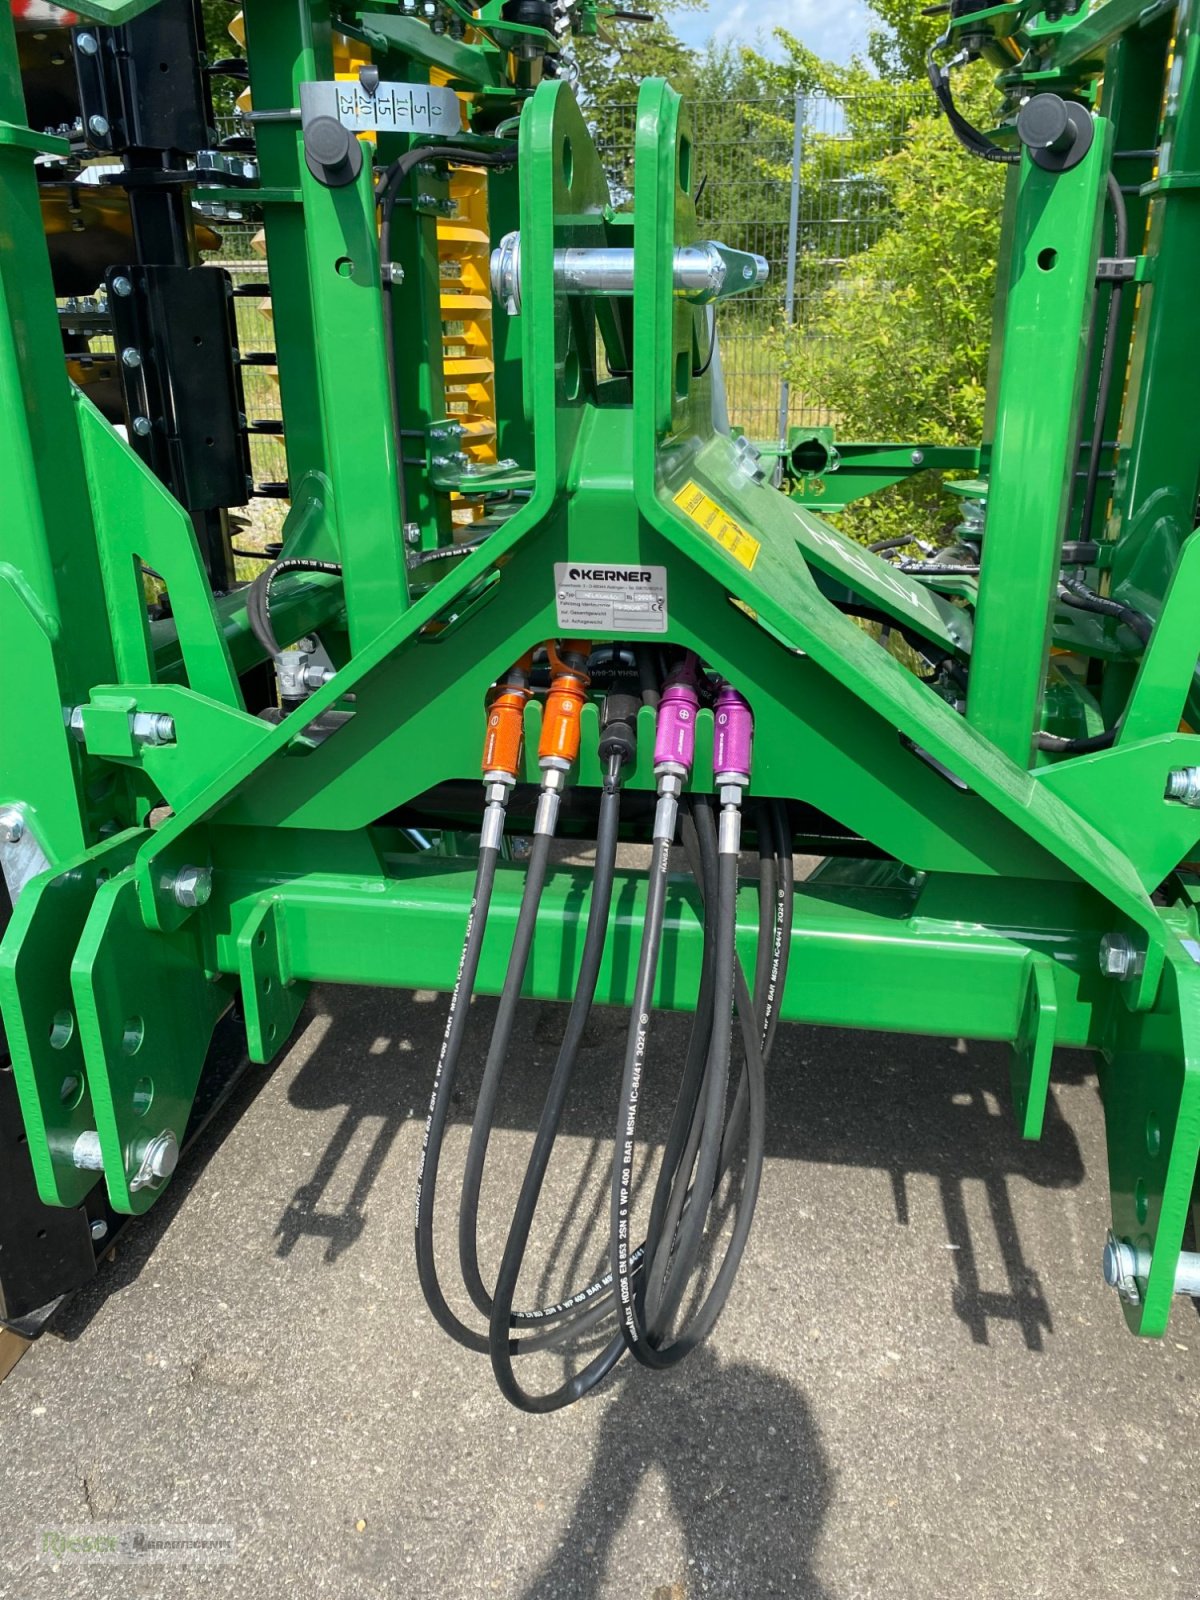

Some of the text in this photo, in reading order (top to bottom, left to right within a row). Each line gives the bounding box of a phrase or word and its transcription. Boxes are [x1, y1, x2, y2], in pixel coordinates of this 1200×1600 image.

[340, 96, 355, 114] 25
[359, 96, 373, 115] 20
[378, 97, 392, 116] 15
[396, 98, 409, 117] 10
[414, 105, 426, 114] 5
[431, 107, 442, 116] 0
[581, 569, 652, 583] KERNER
[777, 902, 785, 923] 2Q24
[770, 958, 779, 982] MSHA
[767, 983, 776, 1002] BAR
[636, 1030, 647, 1057] 3Q24
[630, 1062, 642, 1102] IC-84/41
[626, 1104, 637, 1136] MSHA
[623, 1140, 633, 1164] BAR
[621, 1168, 631, 1186] 400
[620, 1187, 629, 1205] WP
[619, 1208, 628, 1216] 6
[618, 1219, 628, 1239] 2SN
[619, 1243, 628, 1260] 853
[619, 1260, 628, 1275] EN
[562, 1299, 574, 1309] WP
[574, 1294, 586, 1304] 400
[586, 1283, 602, 1296] BAR
[601, 1272, 613, 1286] MS
[620, 1276, 630, 1304] HD206
